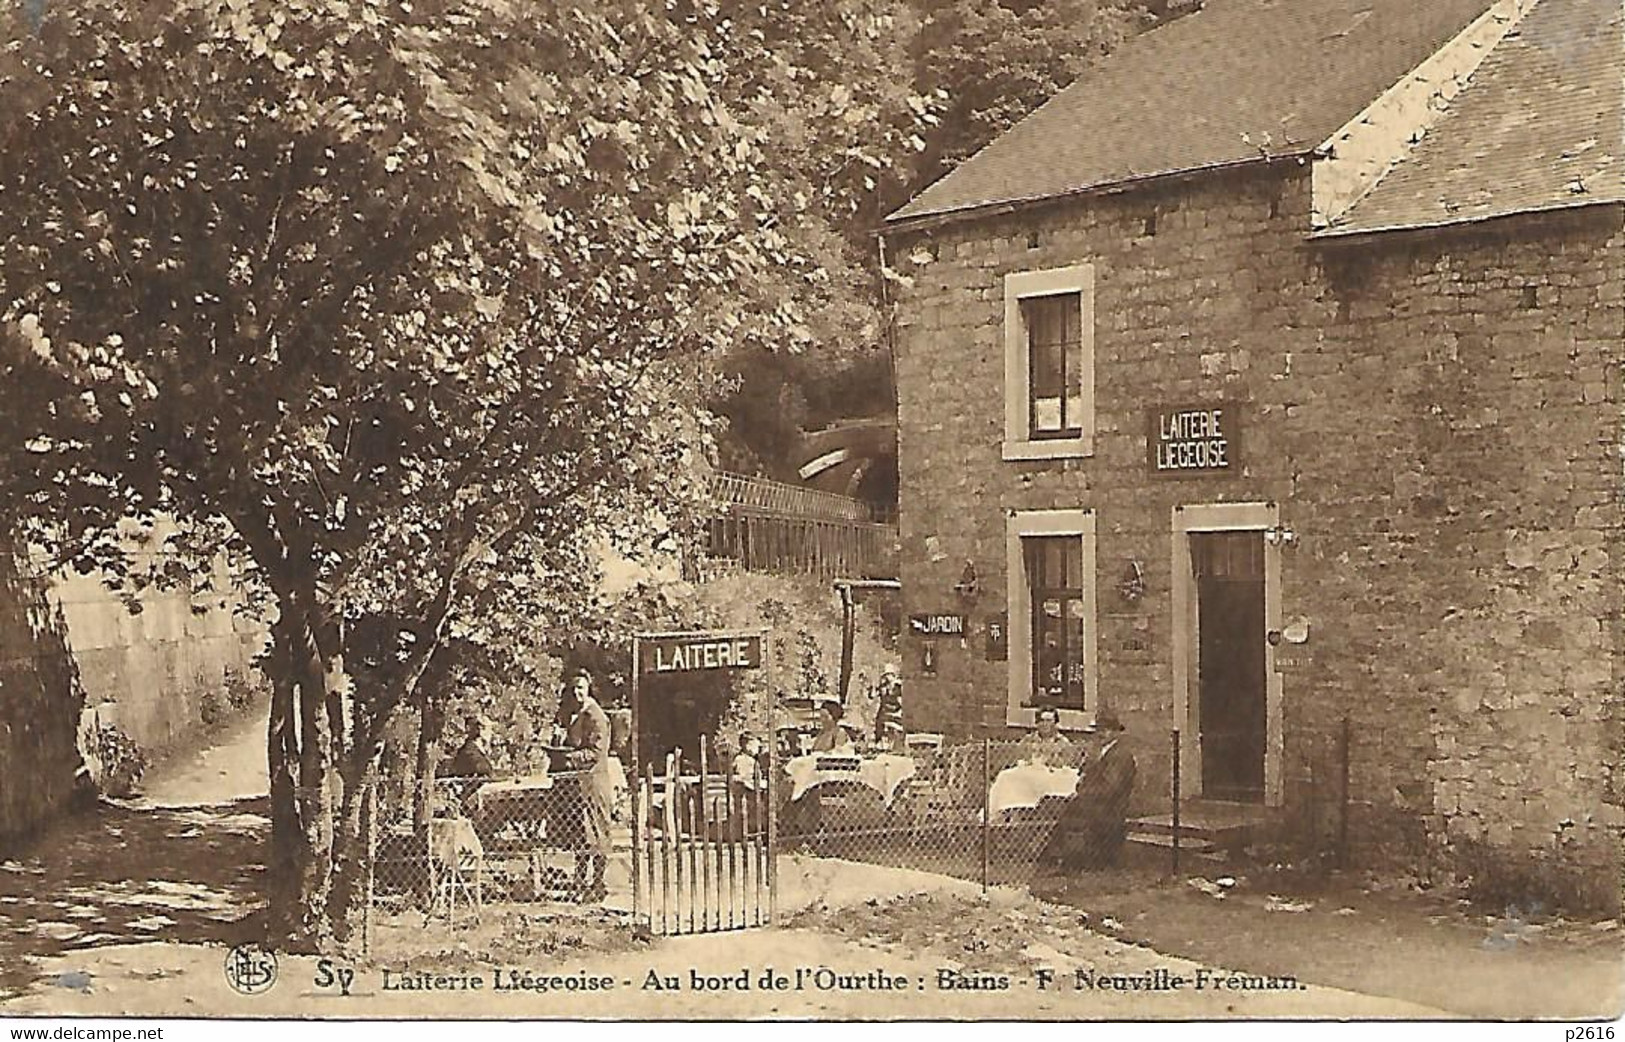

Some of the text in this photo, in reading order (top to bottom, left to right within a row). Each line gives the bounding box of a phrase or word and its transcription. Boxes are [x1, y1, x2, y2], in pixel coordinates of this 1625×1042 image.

[1160, 410, 1222, 440] LAITERIE
[1157, 440, 1229, 470] LIEGEOISE
[923, 616, 963, 633] JARDIN
[657, 642, 750, 671] LAITERIE
